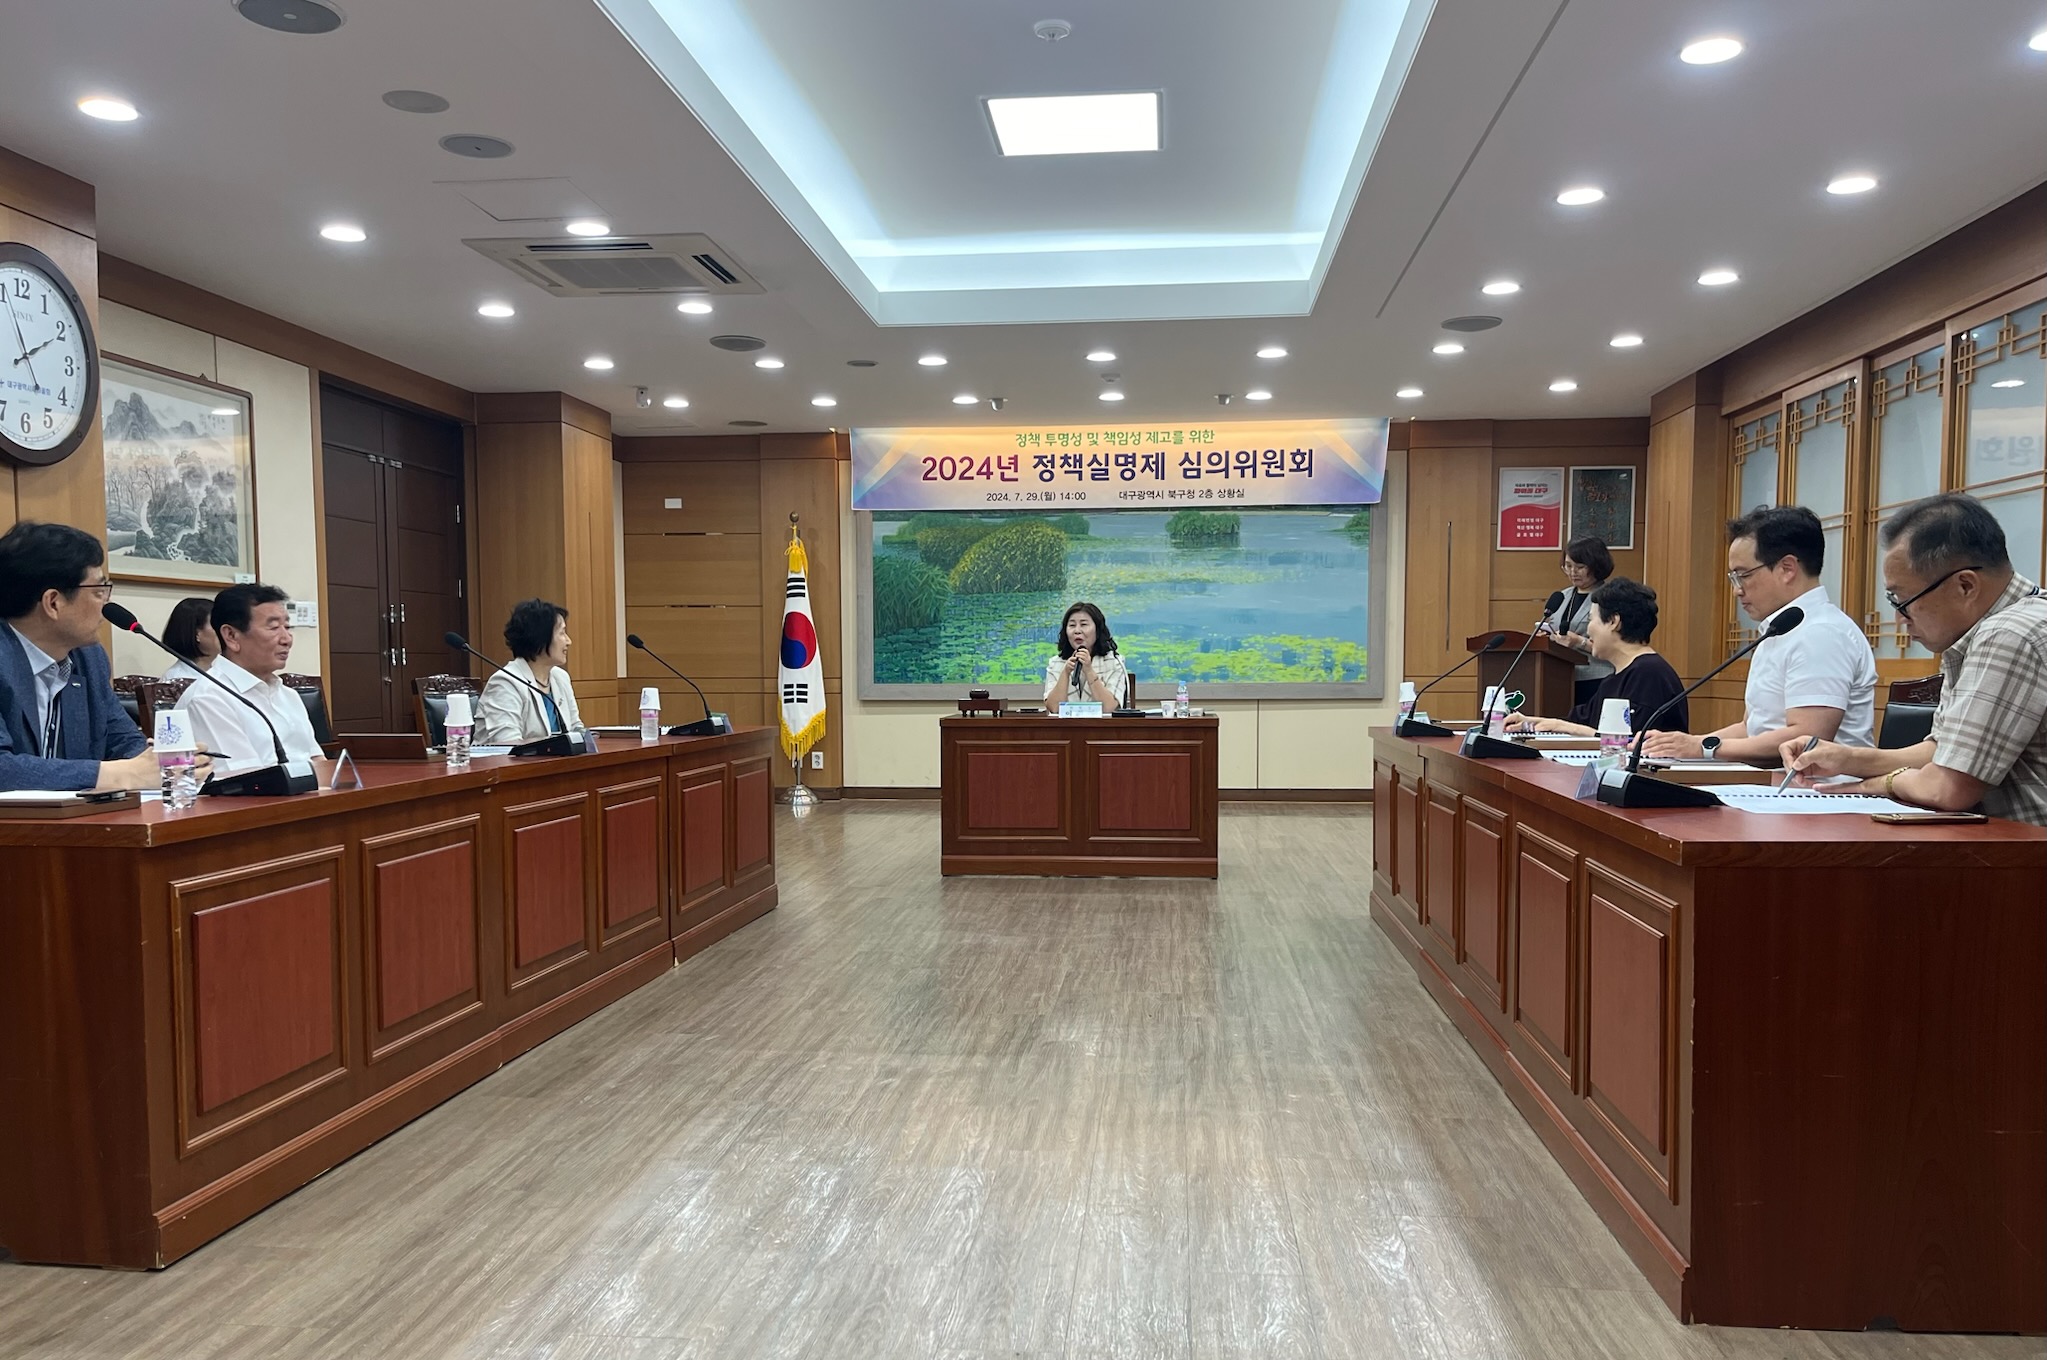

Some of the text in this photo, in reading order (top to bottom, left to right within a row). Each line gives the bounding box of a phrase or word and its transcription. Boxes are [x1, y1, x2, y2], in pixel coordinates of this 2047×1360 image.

[0, 282, 7, 303] 1
[13, 277, 30, 300] 12
[41, 294, 49, 315] 1
[56, 320, 66, 342] 2
[64, 356, 74, 377] 3
[57, 386, 68, 407] 4
[0, 400, 7, 421] 7
[43, 407, 53, 428] 5
[20, 412, 31, 434] 6
[1016, 429, 1215, 447] 정책 투명성 및 책임성 제고를 위한
[921, 448, 1314, 483] 2024년 정책실명제 심의위원회
[986, 488, 1245, 502] 2024. 7. 29.(월) 14:00 대구광역시 북구청 2층 상황실
